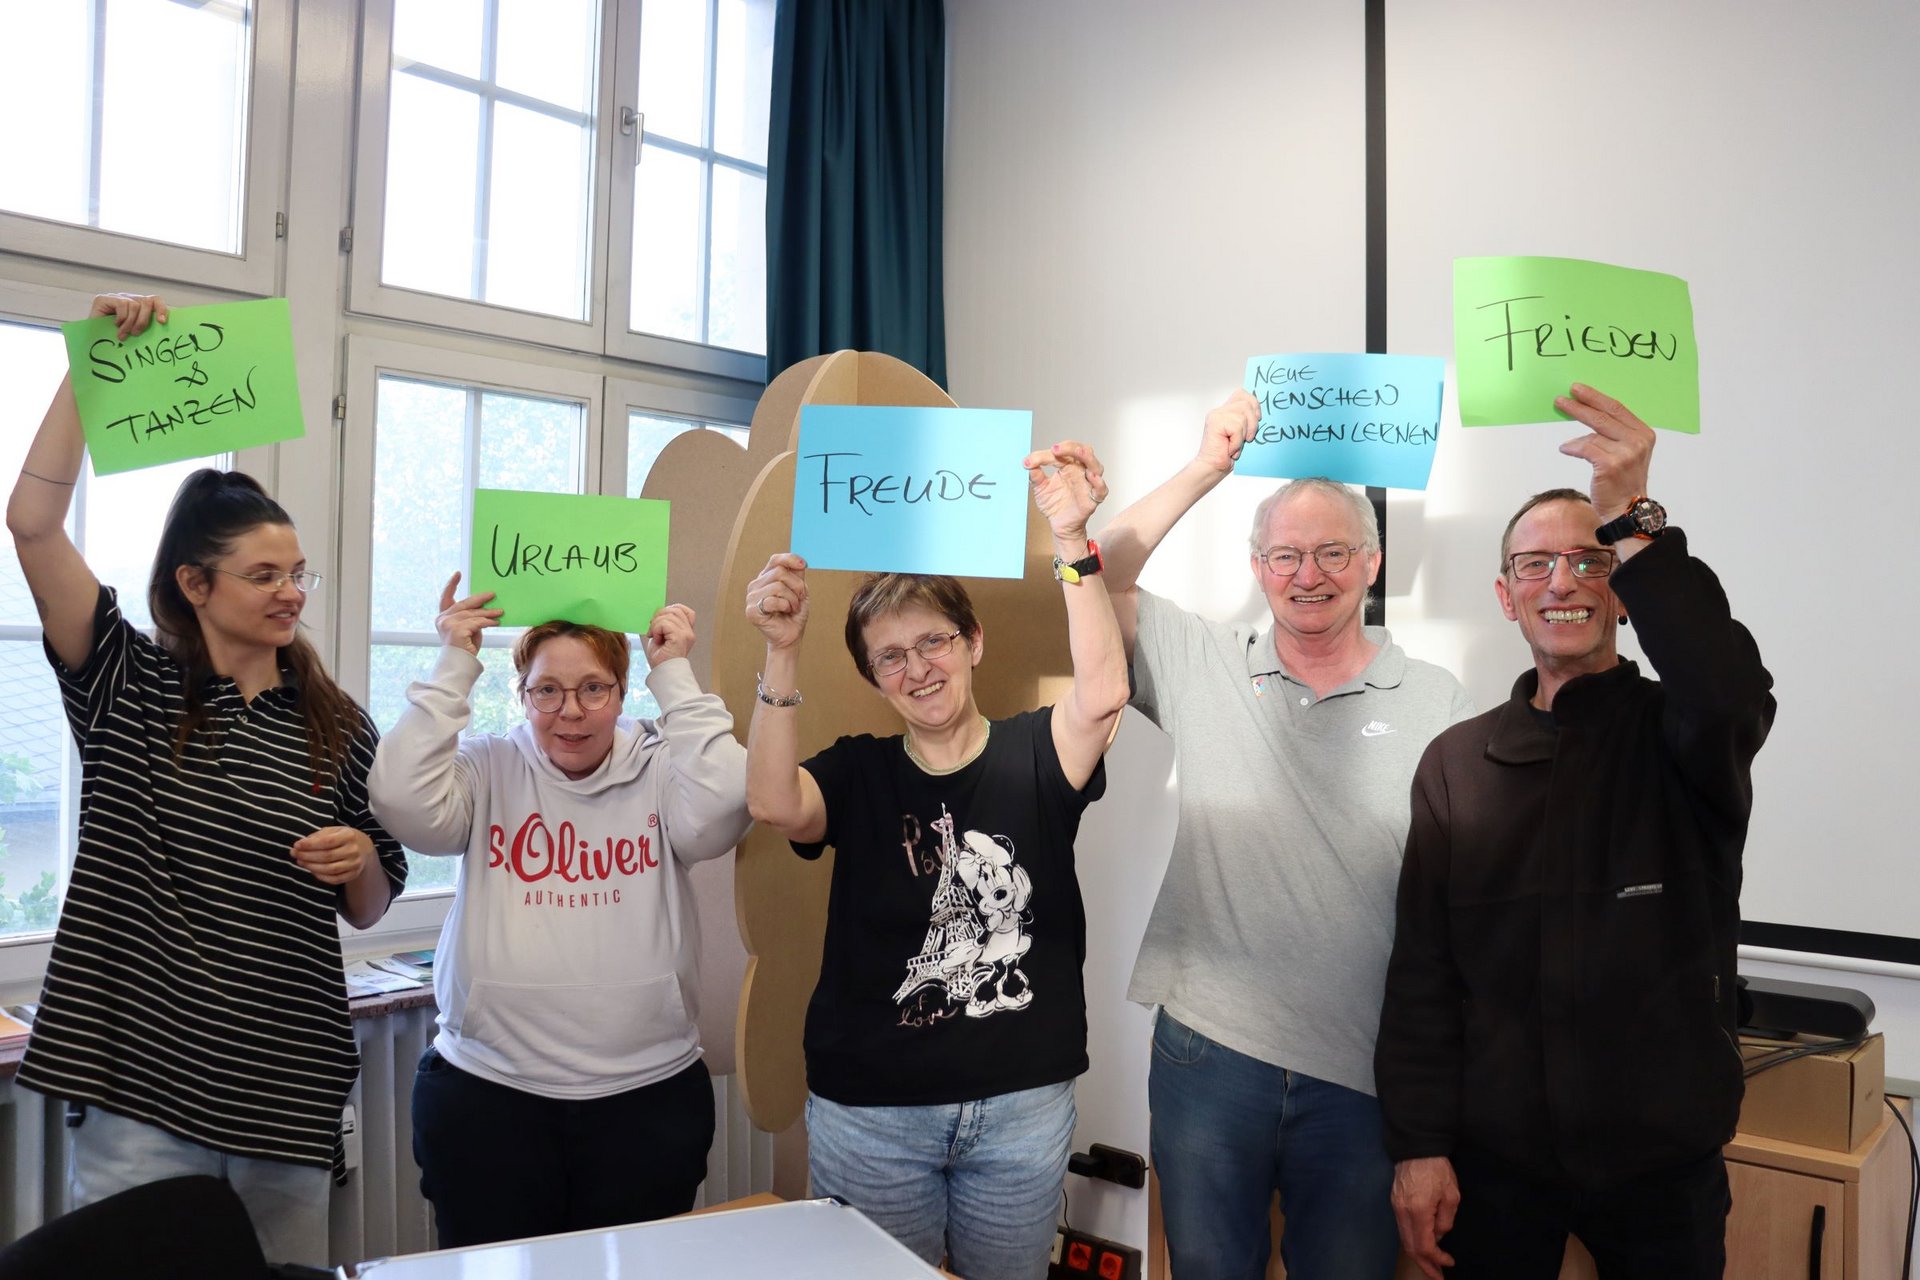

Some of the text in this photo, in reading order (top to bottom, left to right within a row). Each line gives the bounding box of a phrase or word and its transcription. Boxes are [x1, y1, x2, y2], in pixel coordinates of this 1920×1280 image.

[174, 361, 209, 388] &
[1254, 360, 1319, 387] NEUE
[105, 365, 258, 444] TANZEN
[803, 452, 997, 516] FREUDE
[491, 523, 638, 577] URLAUB
[1367, 720, 1391, 732] NIKE
[524, 888, 621, 908] AUTHENTIC
